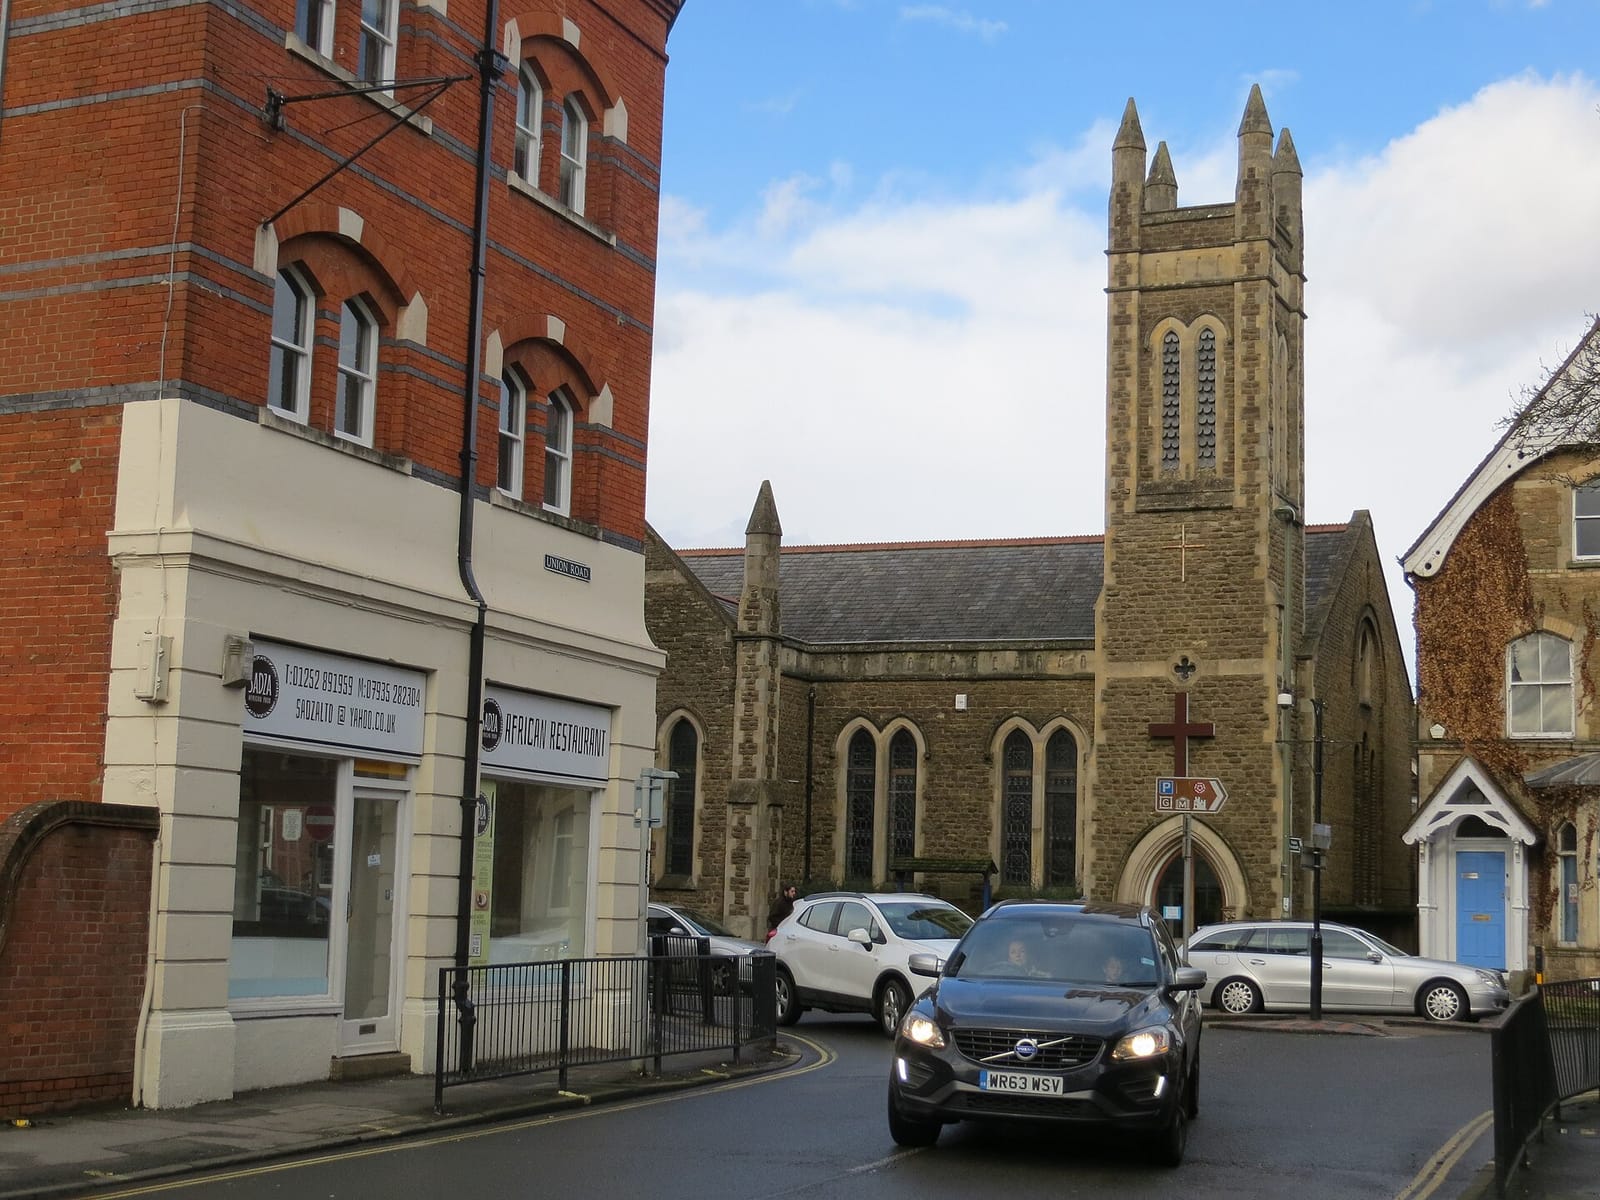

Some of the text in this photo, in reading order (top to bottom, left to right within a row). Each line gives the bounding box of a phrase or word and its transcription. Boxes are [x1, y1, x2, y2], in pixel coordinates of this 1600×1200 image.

[546, 556, 589, 578] UNION ROAD
[286, 664, 421, 708] T:01252 891959 M:07935 282304
[337, 705, 347, 726] @
[349, 707, 397, 734] YAHOO.CO.UK
[504, 713, 606, 757] AFRICAN RESTAURANT
[1162, 782, 1171, 793] P
[1162, 798, 1187, 808] G M
[989, 1073, 1061, 1093] WR63 WSV
